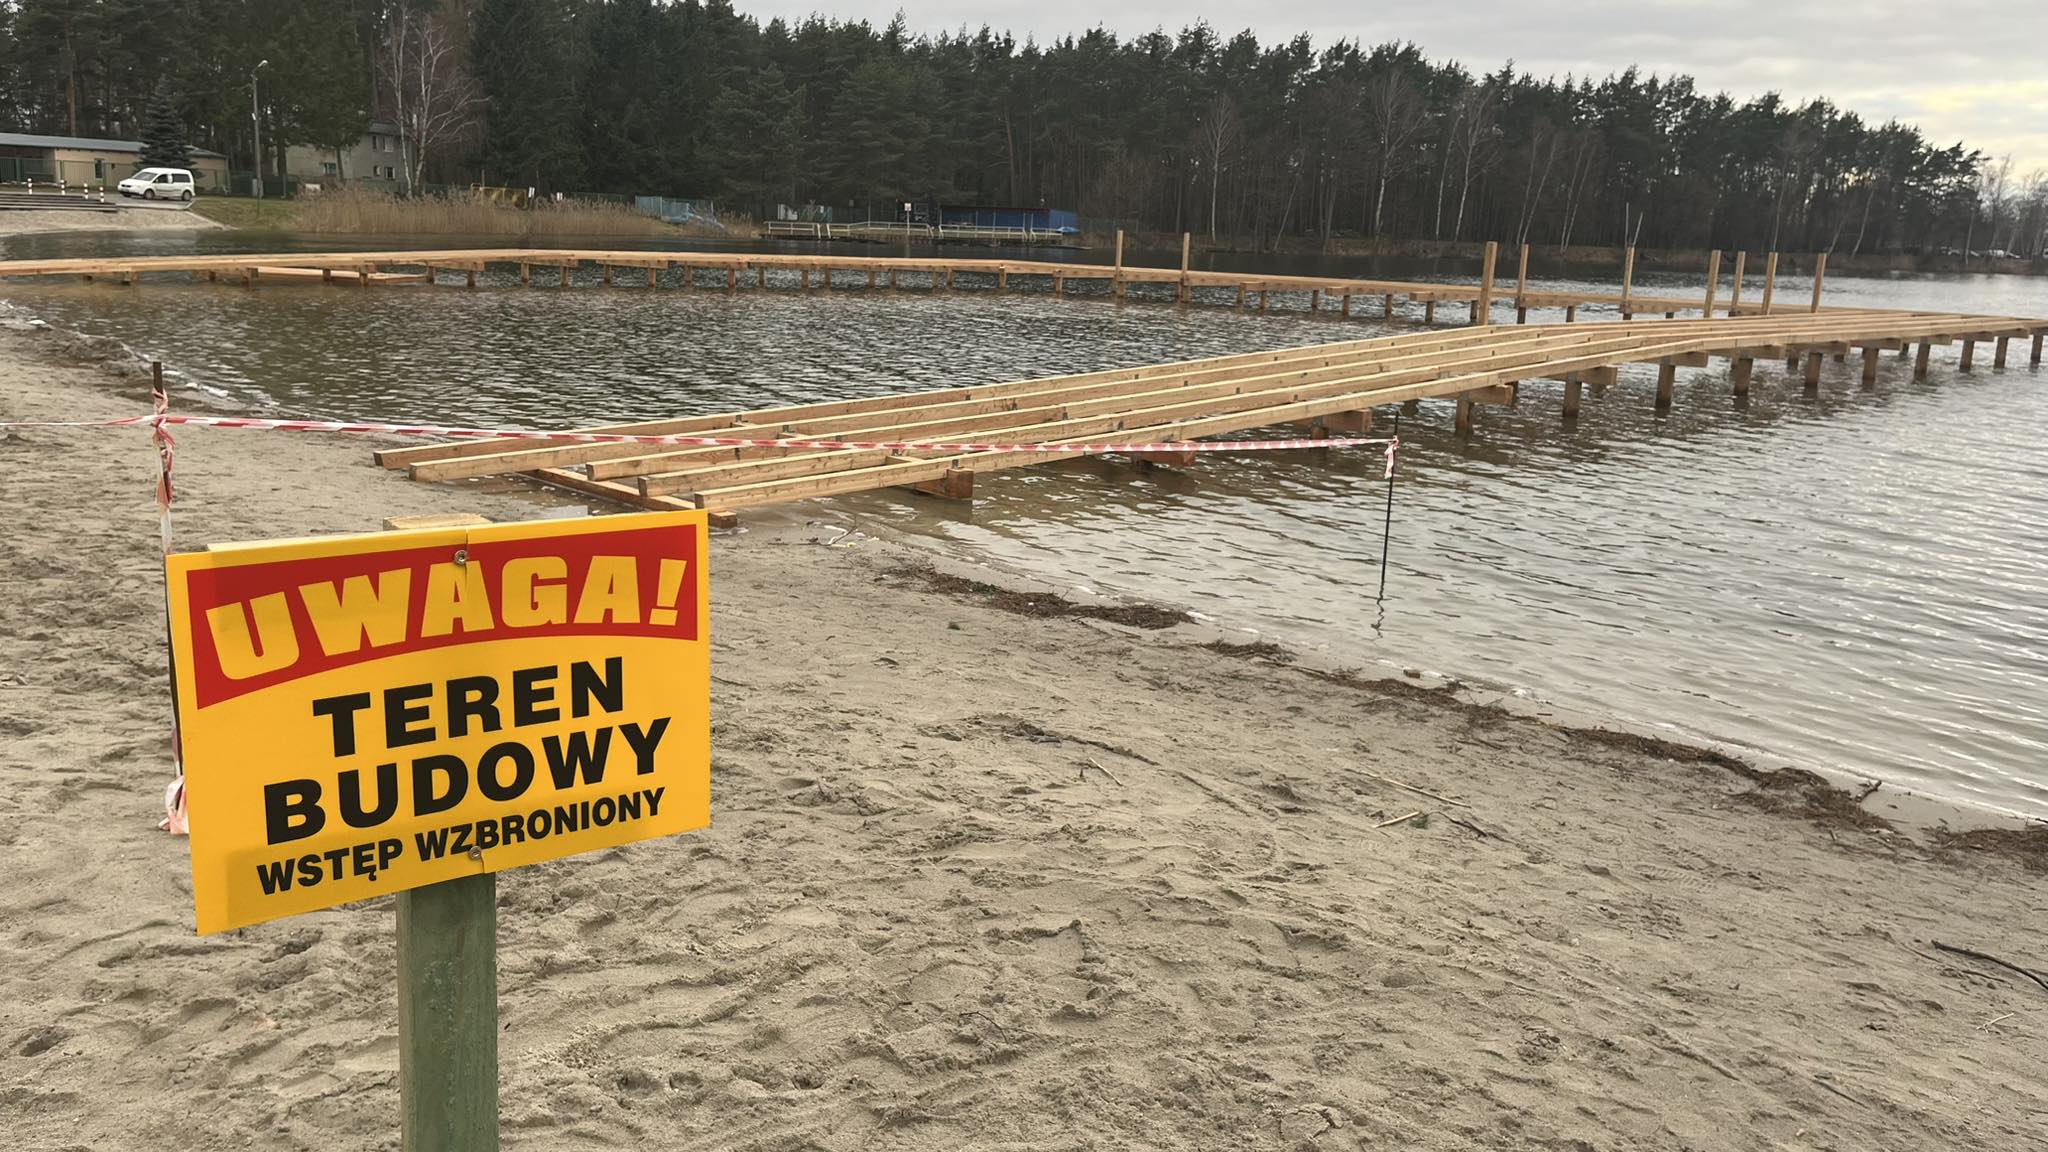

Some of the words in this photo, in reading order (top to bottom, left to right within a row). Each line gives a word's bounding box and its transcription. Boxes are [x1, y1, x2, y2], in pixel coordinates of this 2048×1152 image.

[206, 556, 687, 679] UWAGA!
[313, 656, 623, 757] TEREN
[263, 717, 671, 845] BUDOWY
[256, 838, 403, 895] WSTĘP
[416, 787, 665, 861] WZBRONIONY
